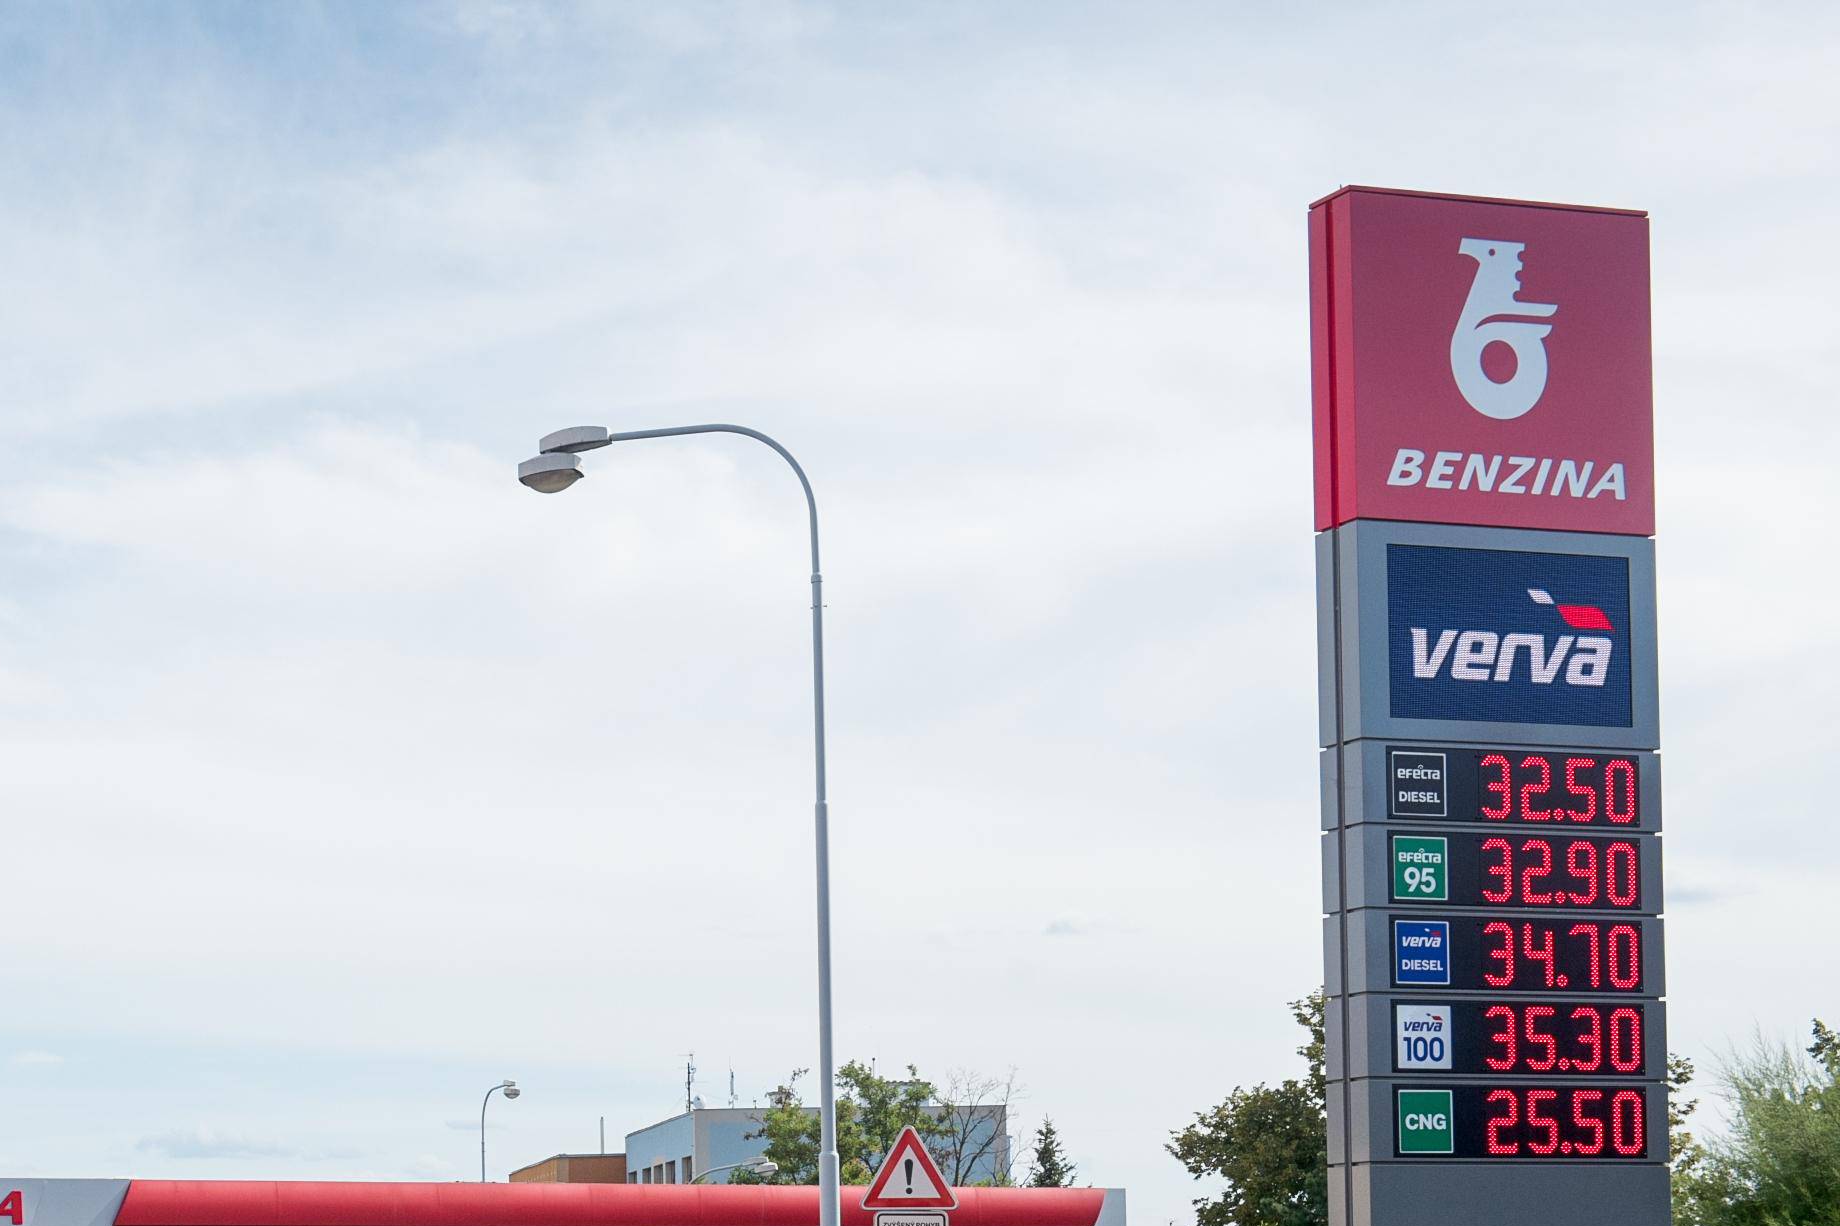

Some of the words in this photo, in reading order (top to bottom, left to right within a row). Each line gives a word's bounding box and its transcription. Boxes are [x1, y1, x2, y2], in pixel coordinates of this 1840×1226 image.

[1387, 448, 1626, 500] BENZINA
[1411, 627, 1613, 687] verva
[1397, 764, 1441, 780] efecta
[1399, 791, 1441, 803] DIESEL
[1480, 754, 1635, 824] 32.50
[1398, 848, 1442, 864] efecta
[1403, 866, 1437, 893] 95
[1481, 838, 1637, 906] 32.90
[1402, 936, 1442, 948] verva
[1401, 959, 1443, 971] DIESEL
[1482, 922, 1639, 989] 34.70
[1403, 1021, 1443, 1032] verva
[1484, 1005, 1640, 1072] 35.30
[1403, 1037, 1445, 1062] 100
[1405, 1113, 1447, 1131] CNG
[1486, 1089, 1643, 1155] 25.50
